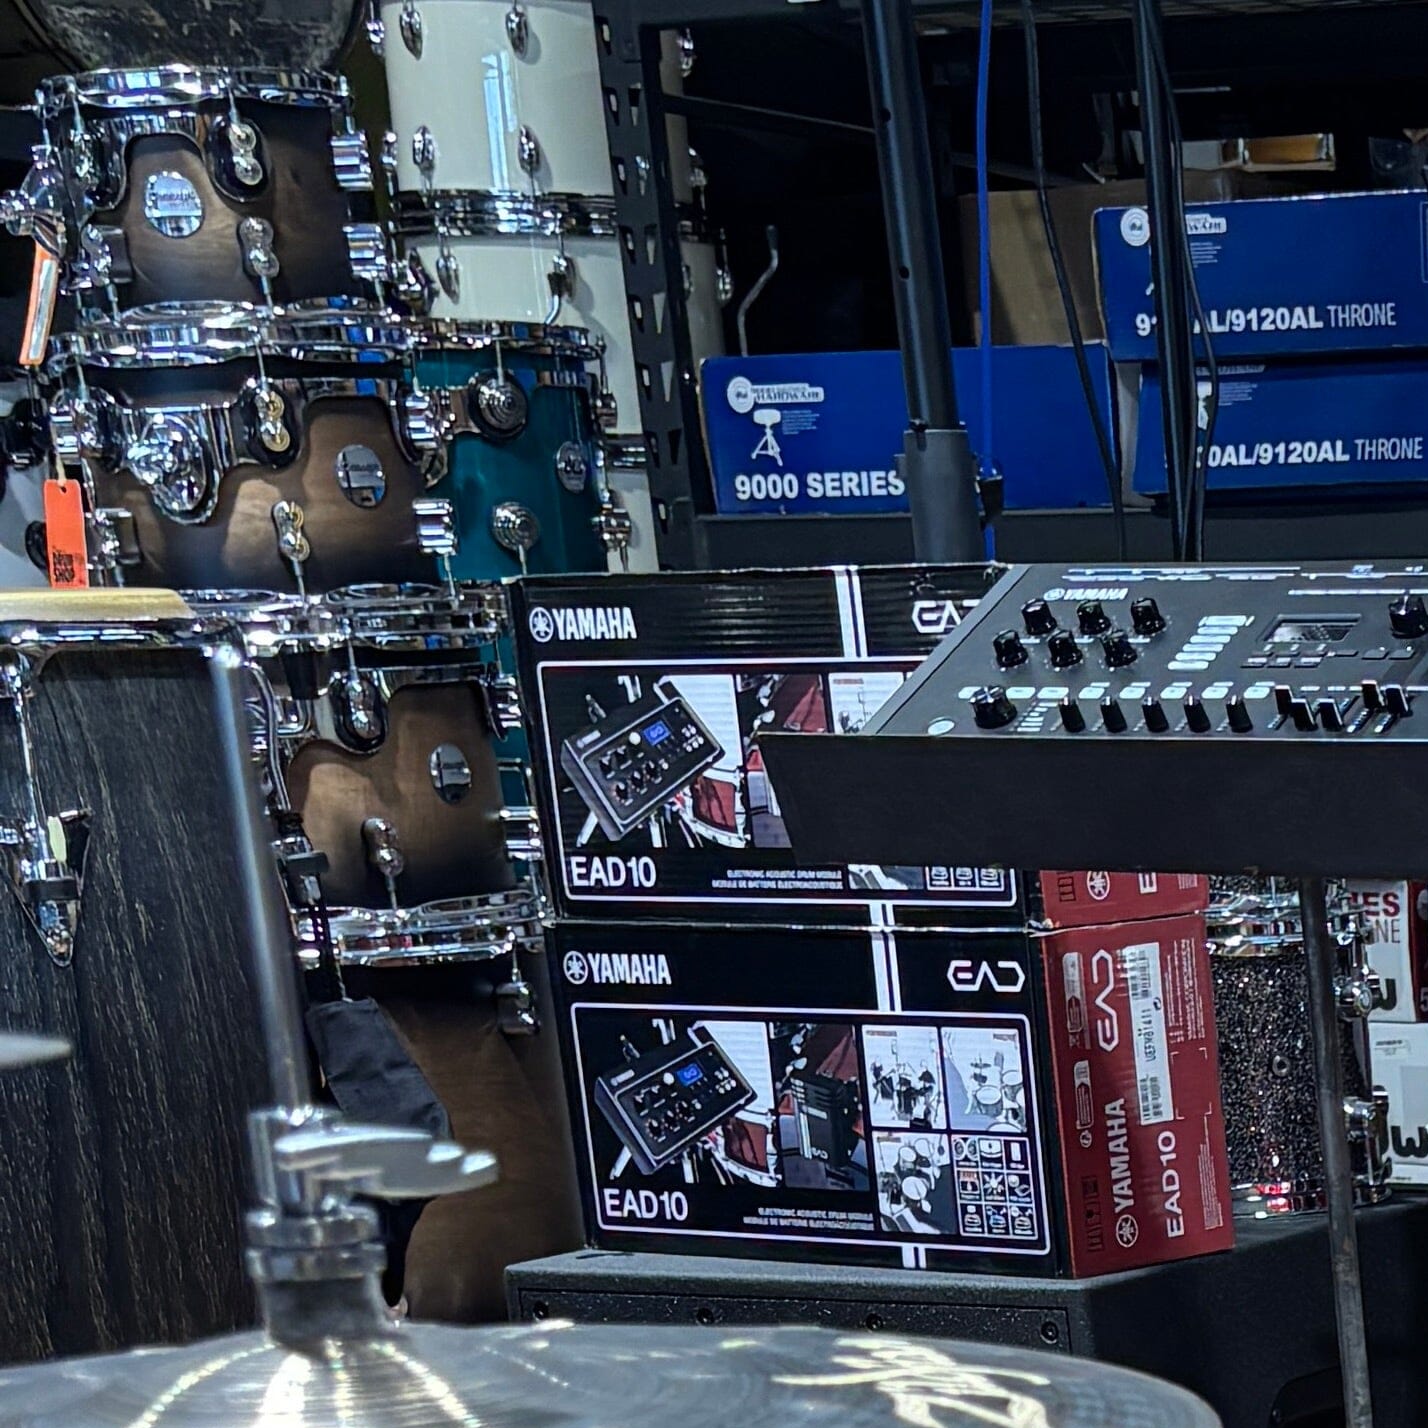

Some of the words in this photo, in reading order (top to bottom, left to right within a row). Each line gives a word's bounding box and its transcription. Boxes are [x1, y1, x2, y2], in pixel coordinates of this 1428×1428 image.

[1327, 302, 1397, 329] THRONE
[1354, 437, 1423, 461] THRONE
[735, 474, 799, 500] 9000
[806, 470, 905, 498] SERIES
[1064, 587, 1128, 601] YAMAHA
[553, 606, 638, 640] YAMAHA
[569, 856, 657, 889] EAD10
[587, 952, 673, 986] YAMAHA
[1104, 1098, 1134, 1215] YAMAHA
[1156, 1130, 1185, 1238] EAD10
[605, 1187, 689, 1223] EAD10
